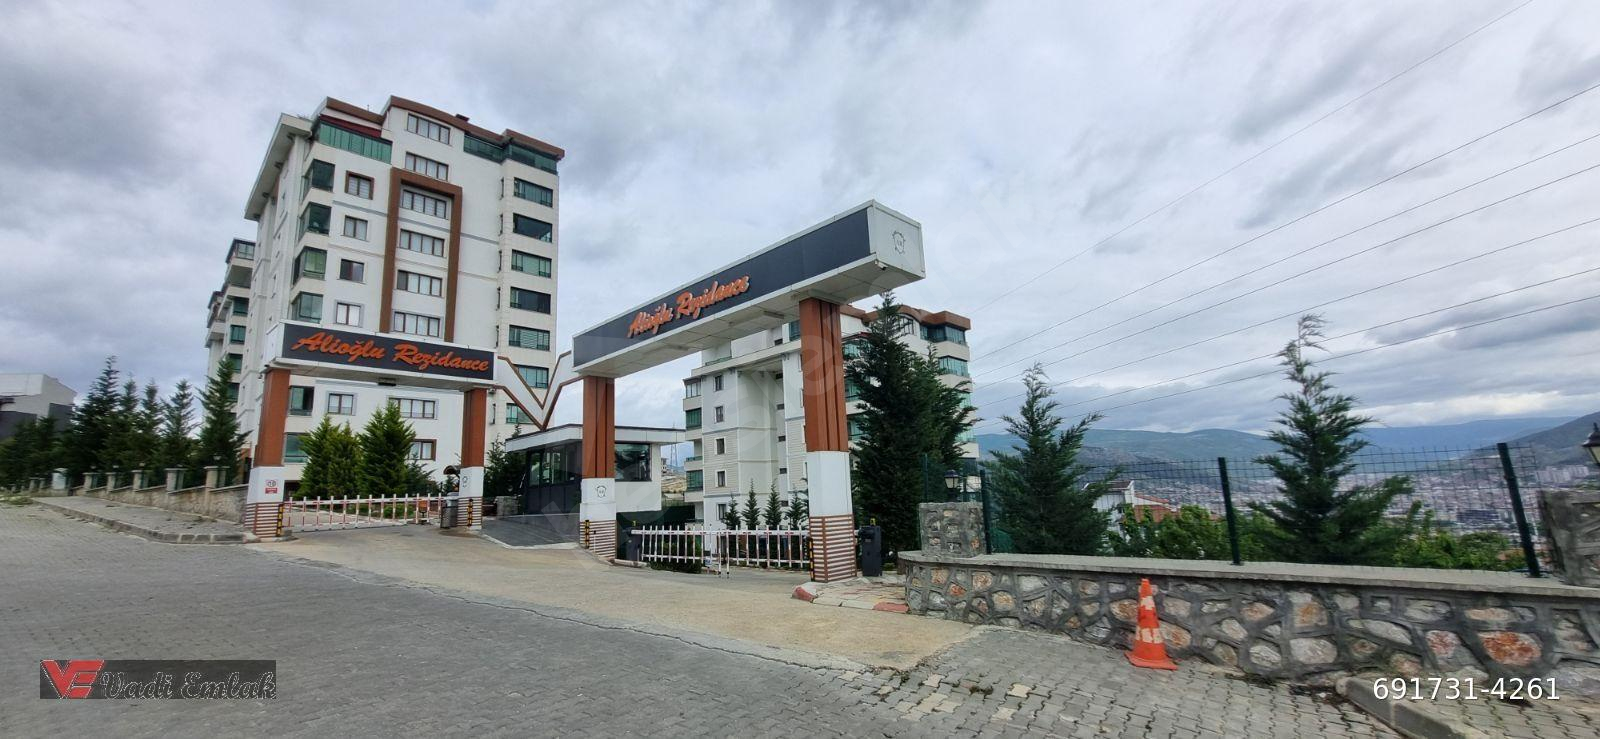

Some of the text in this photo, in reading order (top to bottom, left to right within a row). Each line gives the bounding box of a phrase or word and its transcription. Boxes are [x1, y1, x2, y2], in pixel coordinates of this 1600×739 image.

[675, 274, 750, 320] Rezidance
[291, 331, 489, 371] Alioğlu Rezidance
